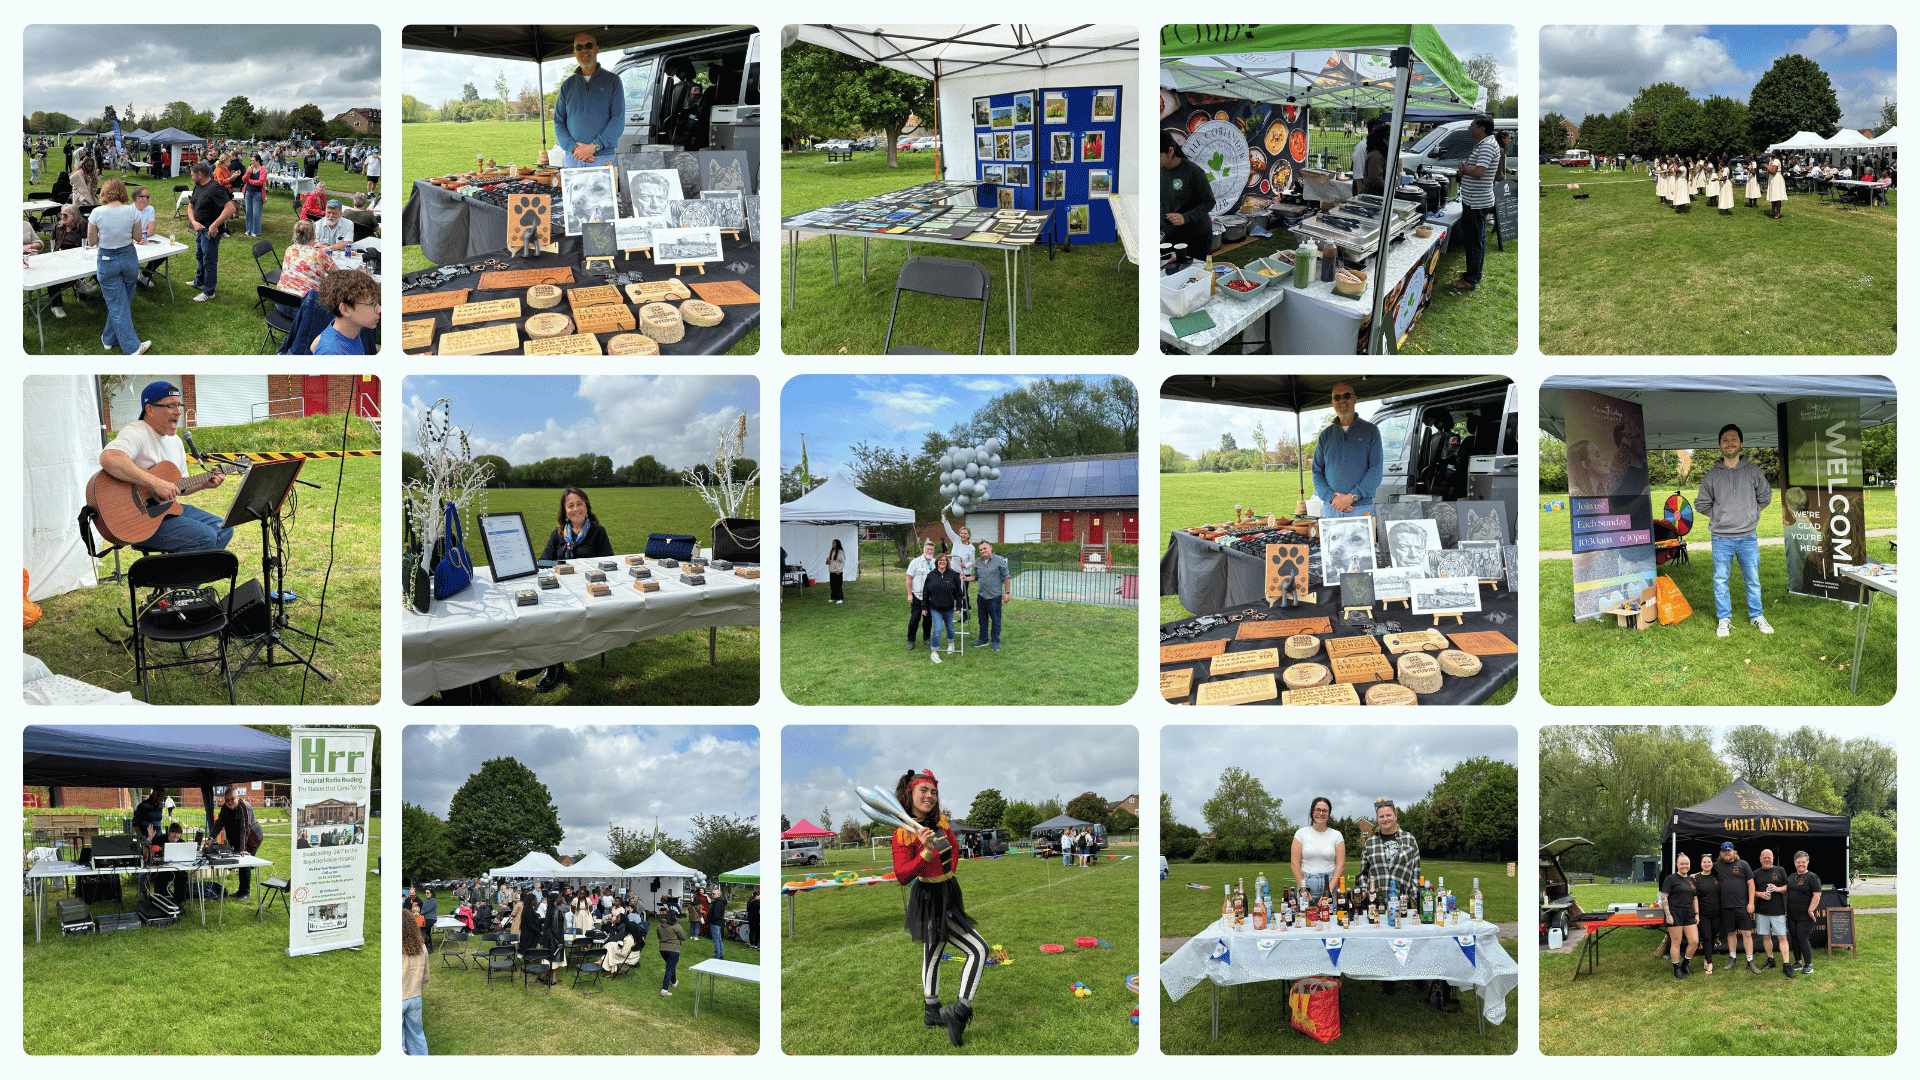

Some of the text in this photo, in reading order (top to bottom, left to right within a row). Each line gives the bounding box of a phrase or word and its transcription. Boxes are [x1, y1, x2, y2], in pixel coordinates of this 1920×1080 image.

[1793, 510, 1820, 519] WE'RE
[1798, 522, 1821, 530] GLAD
[1791, 533, 1823, 542] YOU'RE
[1800, 545, 1824, 553] HERE
[301, 738, 365, 773] Hrr
[1723, 816, 1809, 832] GRILL MASTERS
